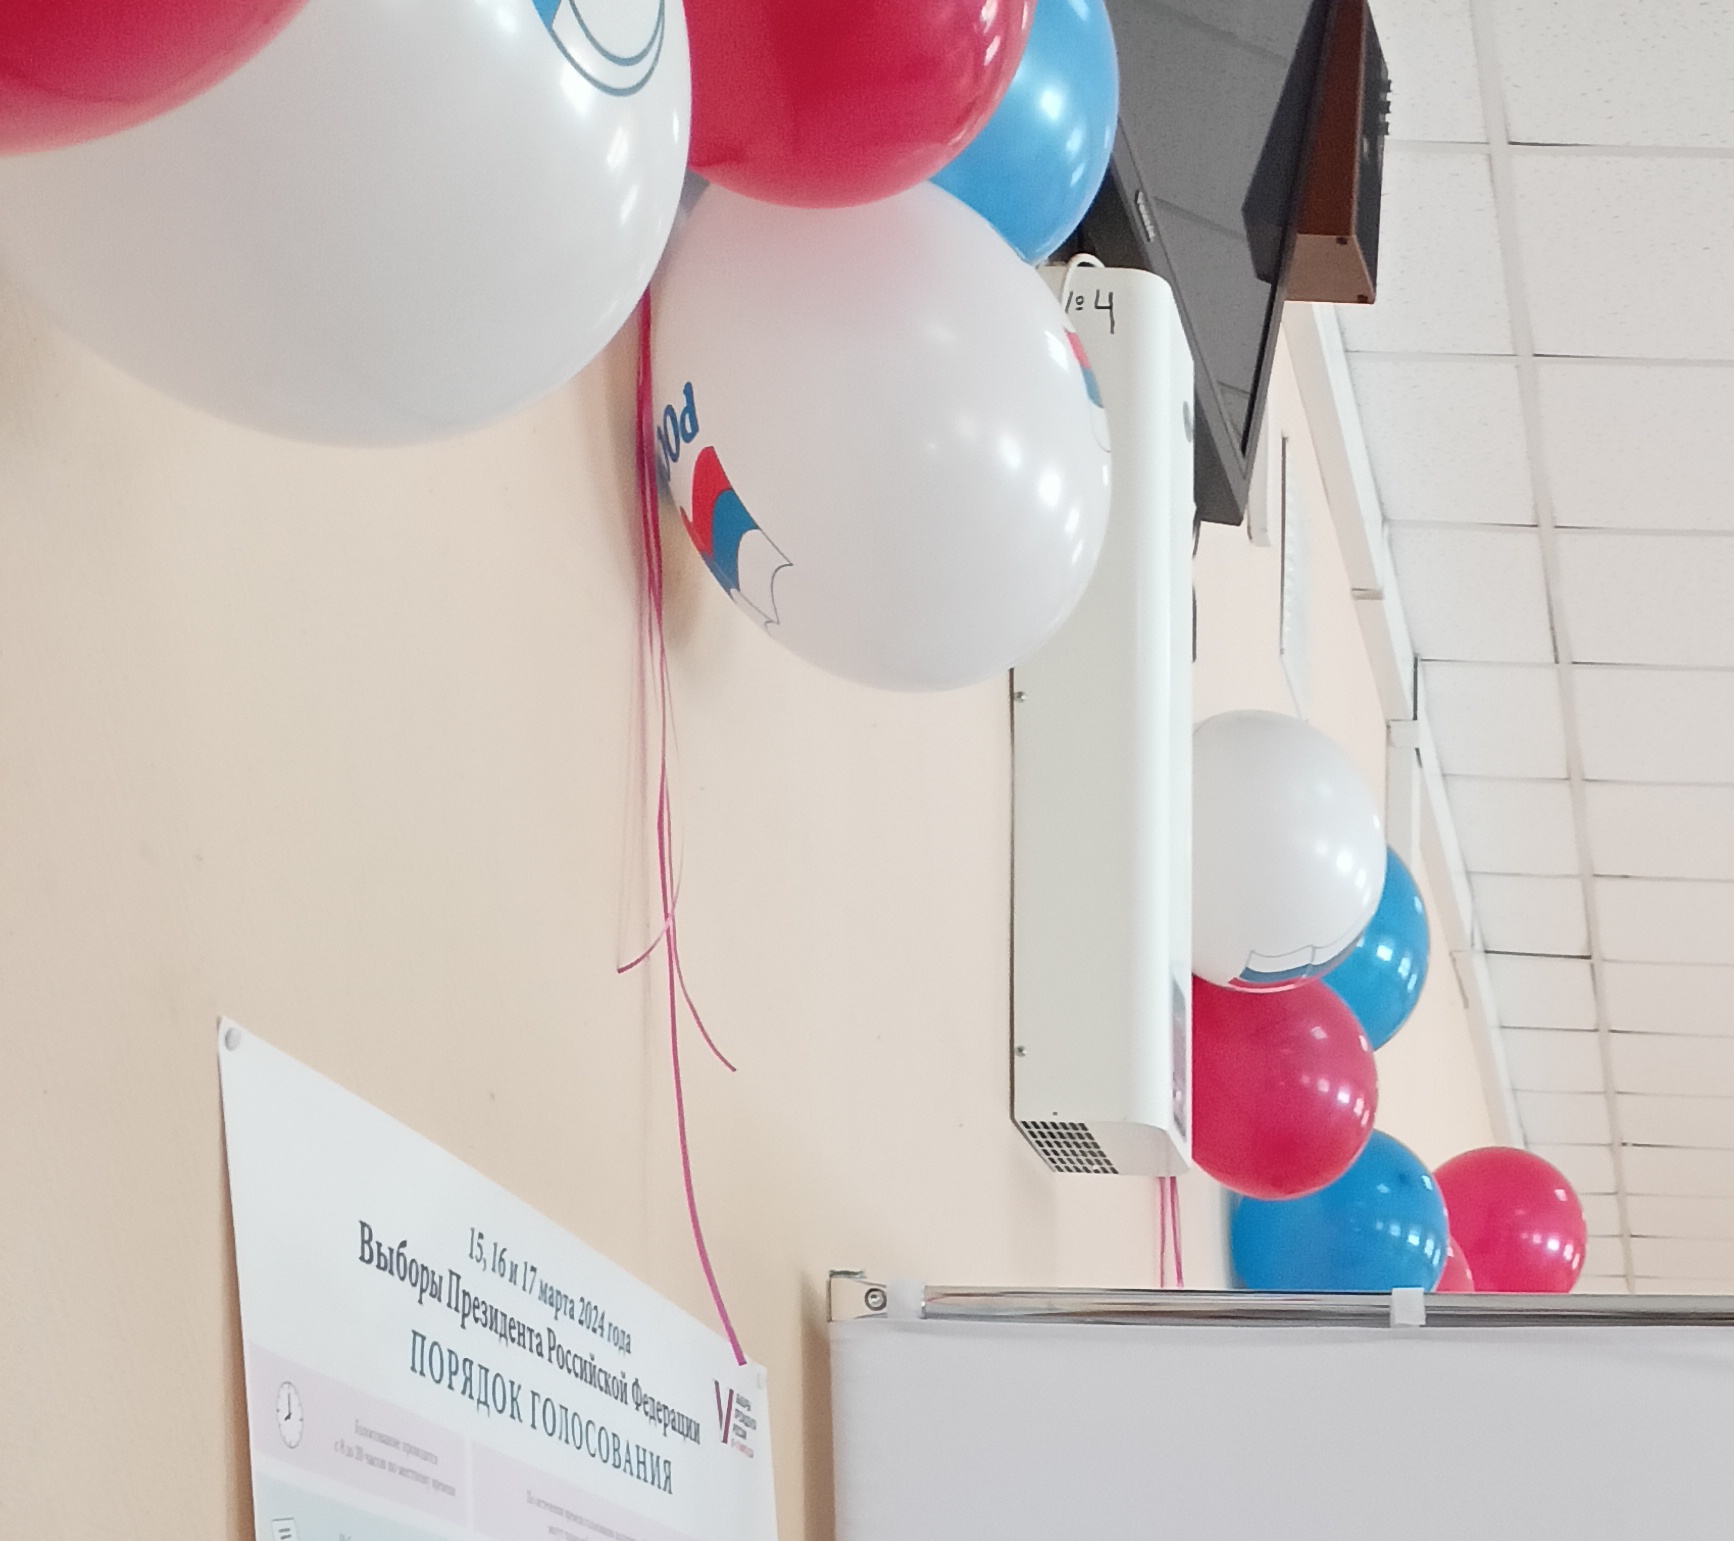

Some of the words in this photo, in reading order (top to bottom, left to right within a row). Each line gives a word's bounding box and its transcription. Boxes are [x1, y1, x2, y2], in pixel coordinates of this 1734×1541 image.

[359, 1219, 443, 1306] Выборы
[446, 1268, 544, 1359] Президента
[546, 1326, 629, 1406] Российской
[631, 1377, 701, 1445] Федерации
[469, 1227, 487, 1272] 15,
[491, 1242, 507, 1278] 16
[509, 1260, 519, 1286] и
[522, 1261, 538, 1295] 17
[538, 1278, 575, 1321] марта
[578, 1296, 606, 1341] 2024
[607, 1322, 632, 1355] года
[410, 1329, 523, 1424] ПОРЯДОК
[530, 1389, 674, 1495] ГОЛОСОВАНИЯ
